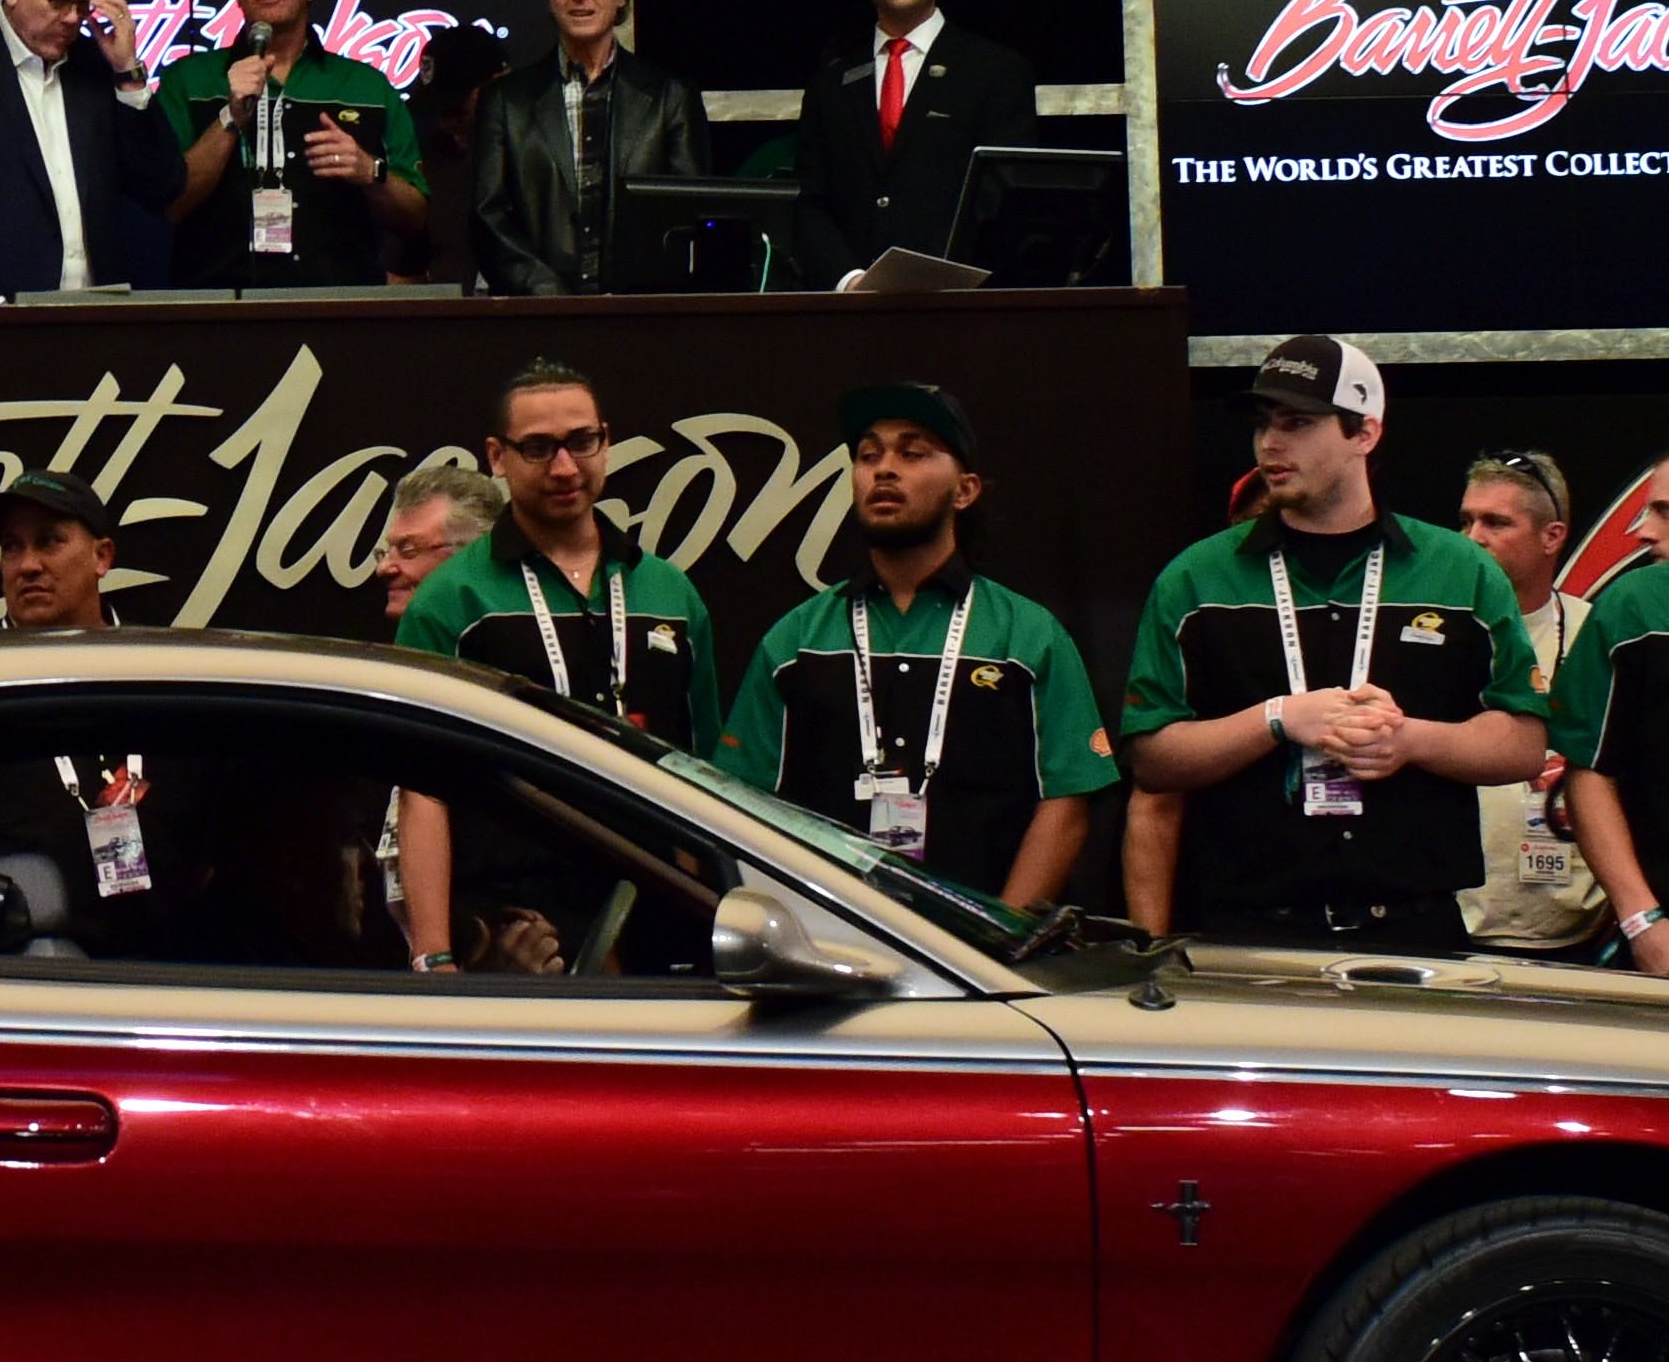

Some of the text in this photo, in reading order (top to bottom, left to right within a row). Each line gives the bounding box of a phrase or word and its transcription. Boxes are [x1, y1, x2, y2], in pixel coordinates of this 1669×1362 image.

[1361, 552, 1381, 641] BARRETT-JAC
[936, 606, 966, 706] BARRETT-JAC
[1312, 786, 1321, 800] E
[1526, 854, 1565, 871] 1695
[102, 865, 112, 879] E
